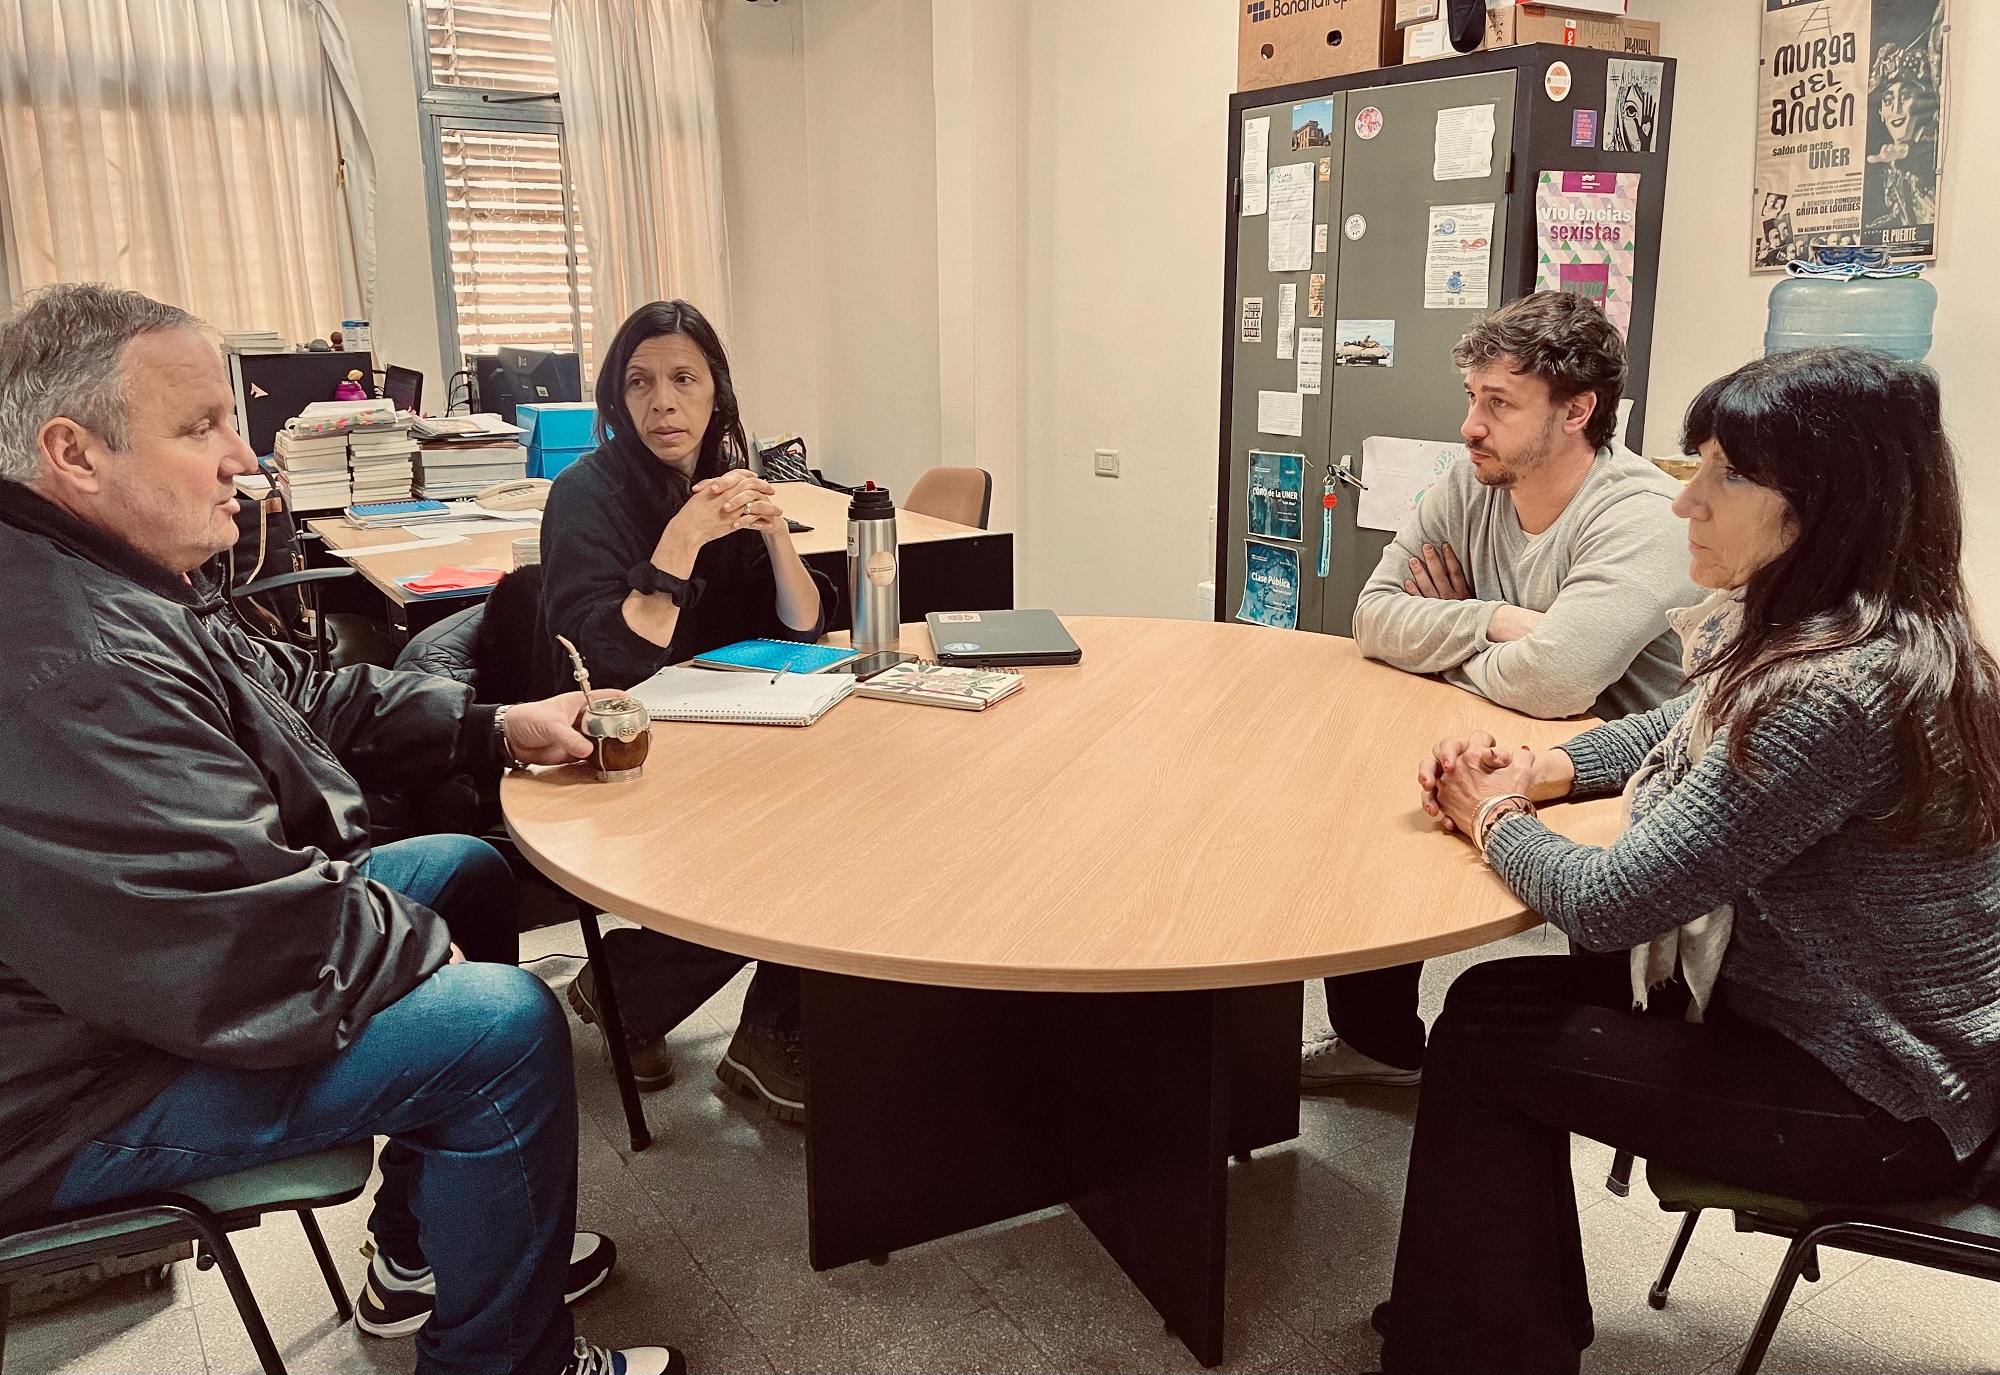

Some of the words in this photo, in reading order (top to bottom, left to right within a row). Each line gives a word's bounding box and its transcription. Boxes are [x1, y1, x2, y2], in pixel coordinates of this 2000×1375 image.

[1624, 37, 1651, 55] ThinkPad
[1772, 144, 1796, 157] salón
[1796, 143, 1808, 153] de
[1809, 140, 1834, 152] actos
[1808, 147, 1850, 170] UNER
[1540, 203, 1633, 222] violencias
[1796, 206, 1818, 217] GRUTA
[1819, 205, 1829, 214] DE
[1829, 202, 1861, 214] LOURDES
[1550, 221, 1621, 241] sexistas
[1882, 229, 1890, 243] EL
[1890, 227, 1918, 243] PUENTE
[1252, 486, 1268, 496] CORO
[1267, 488, 1275, 498] de
[1275, 489, 1281, 498] la
[1281, 490, 1298, 501] UNER
[1251, 571, 1268, 584] Clase
[1267, 575, 1291, 589] Pública
